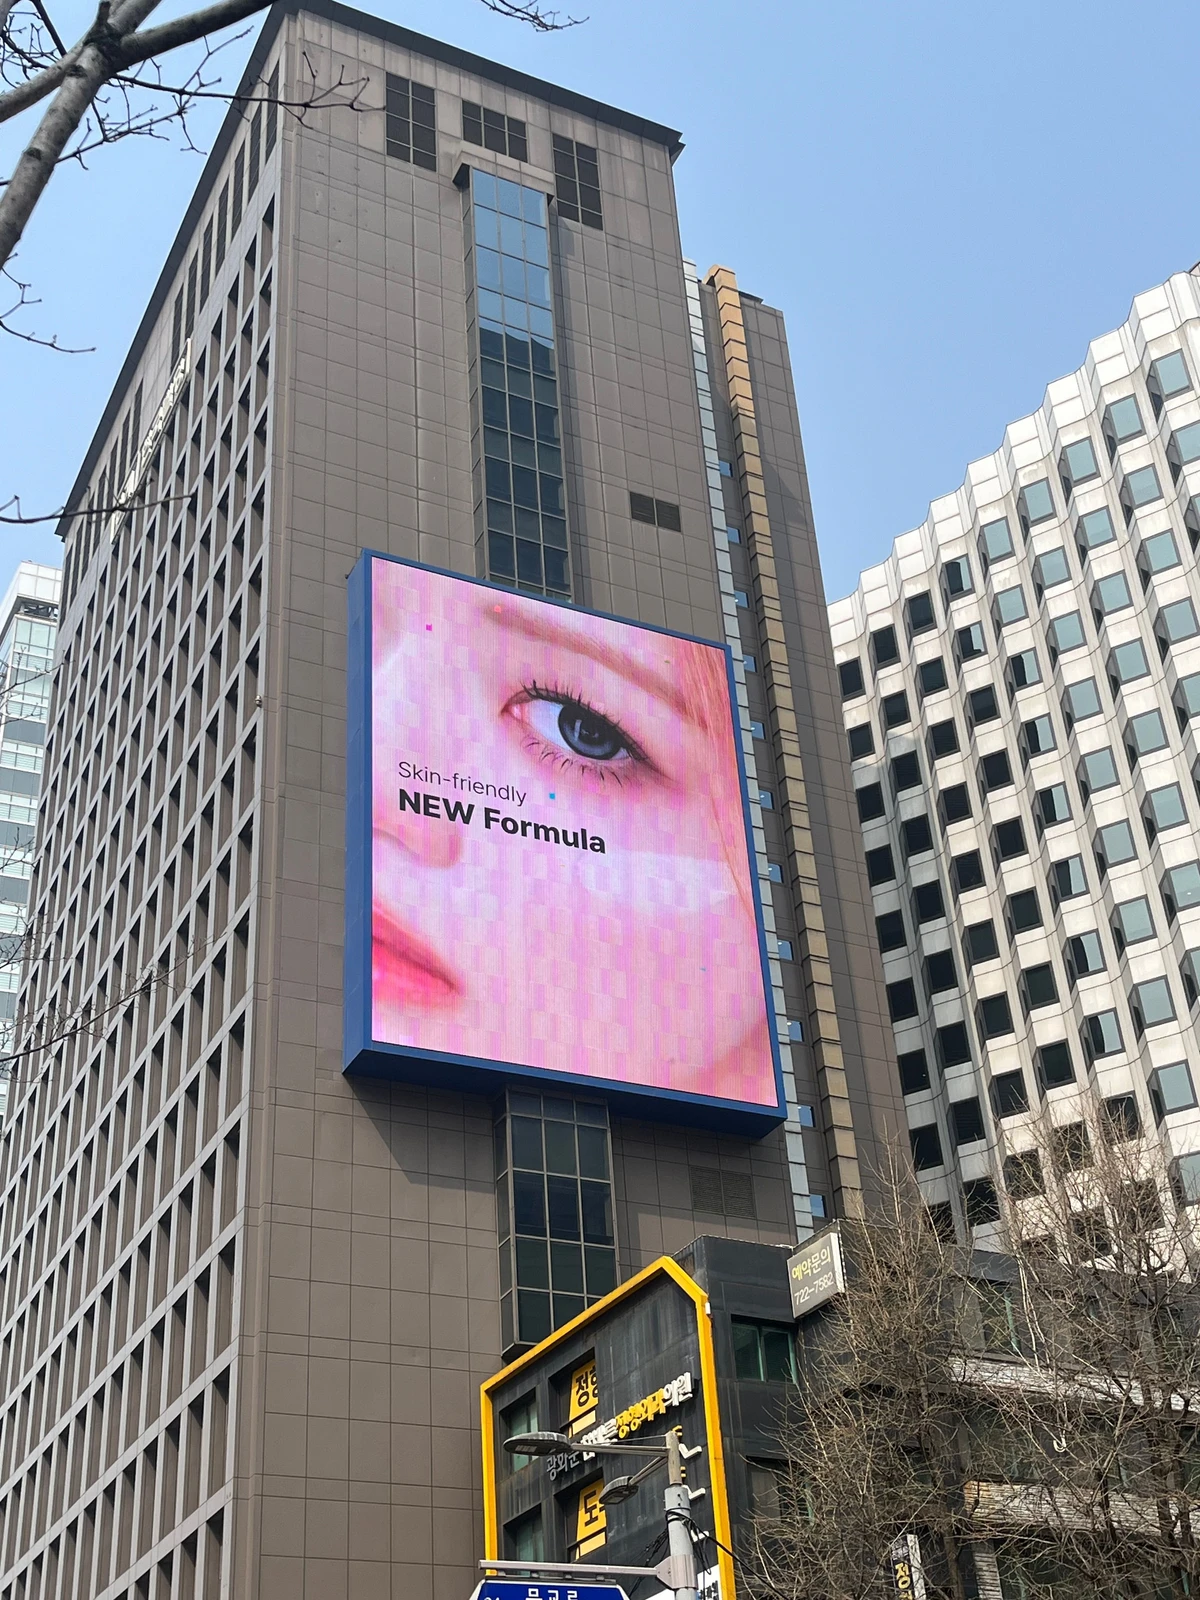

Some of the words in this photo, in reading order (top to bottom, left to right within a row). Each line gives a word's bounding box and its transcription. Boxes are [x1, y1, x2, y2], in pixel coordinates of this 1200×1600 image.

[398, 761, 527, 807] Skin-friendly
[399, 788, 475, 825] NEW
[484, 807, 606, 854] Formula
[791, 1245, 831, 1281] 예약문의
[794, 1271, 835, 1306] 722-7582
